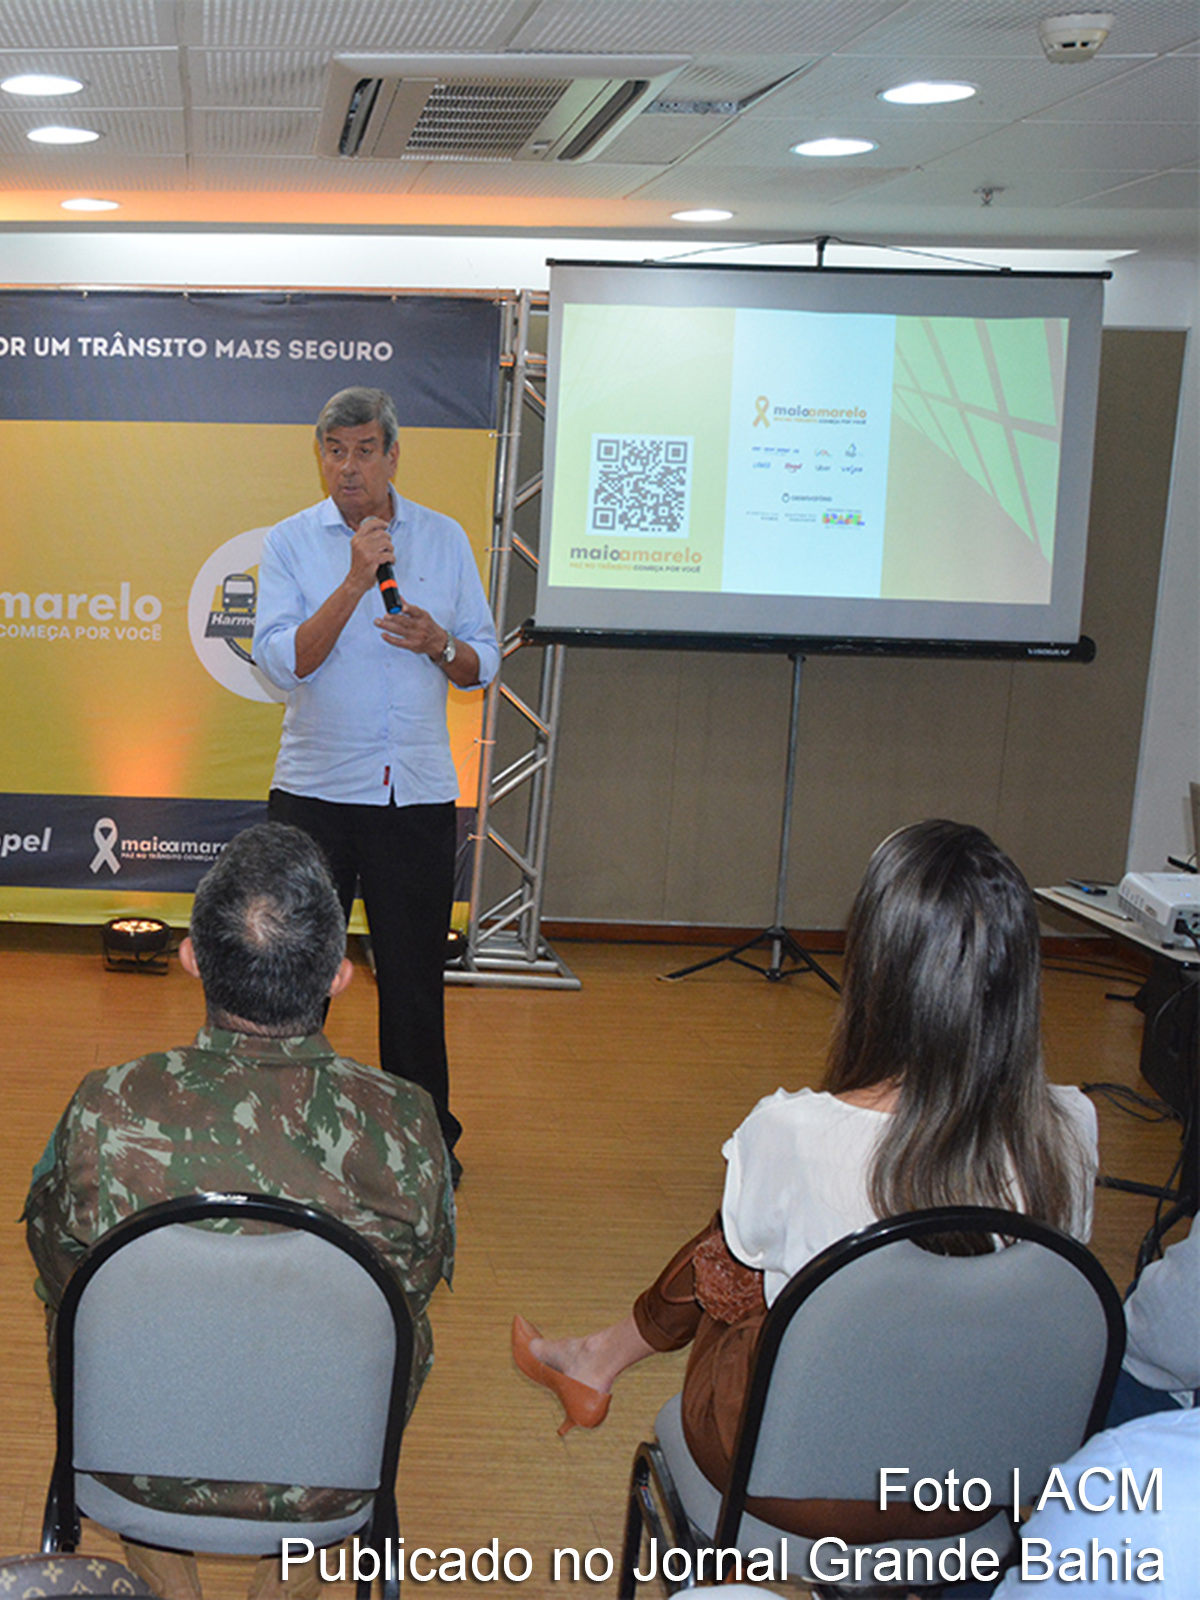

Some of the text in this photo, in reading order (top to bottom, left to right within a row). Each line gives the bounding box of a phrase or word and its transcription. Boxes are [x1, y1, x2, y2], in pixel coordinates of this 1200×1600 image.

[34, 337, 70, 357] UM
[78, 331, 207, 358] TRÂNSITO
[215, 338, 282, 359] MAIS
[289, 340, 393, 361] SEGURO
[75, 626, 110, 640] POR
[115, 624, 162, 641] VOCÊ
